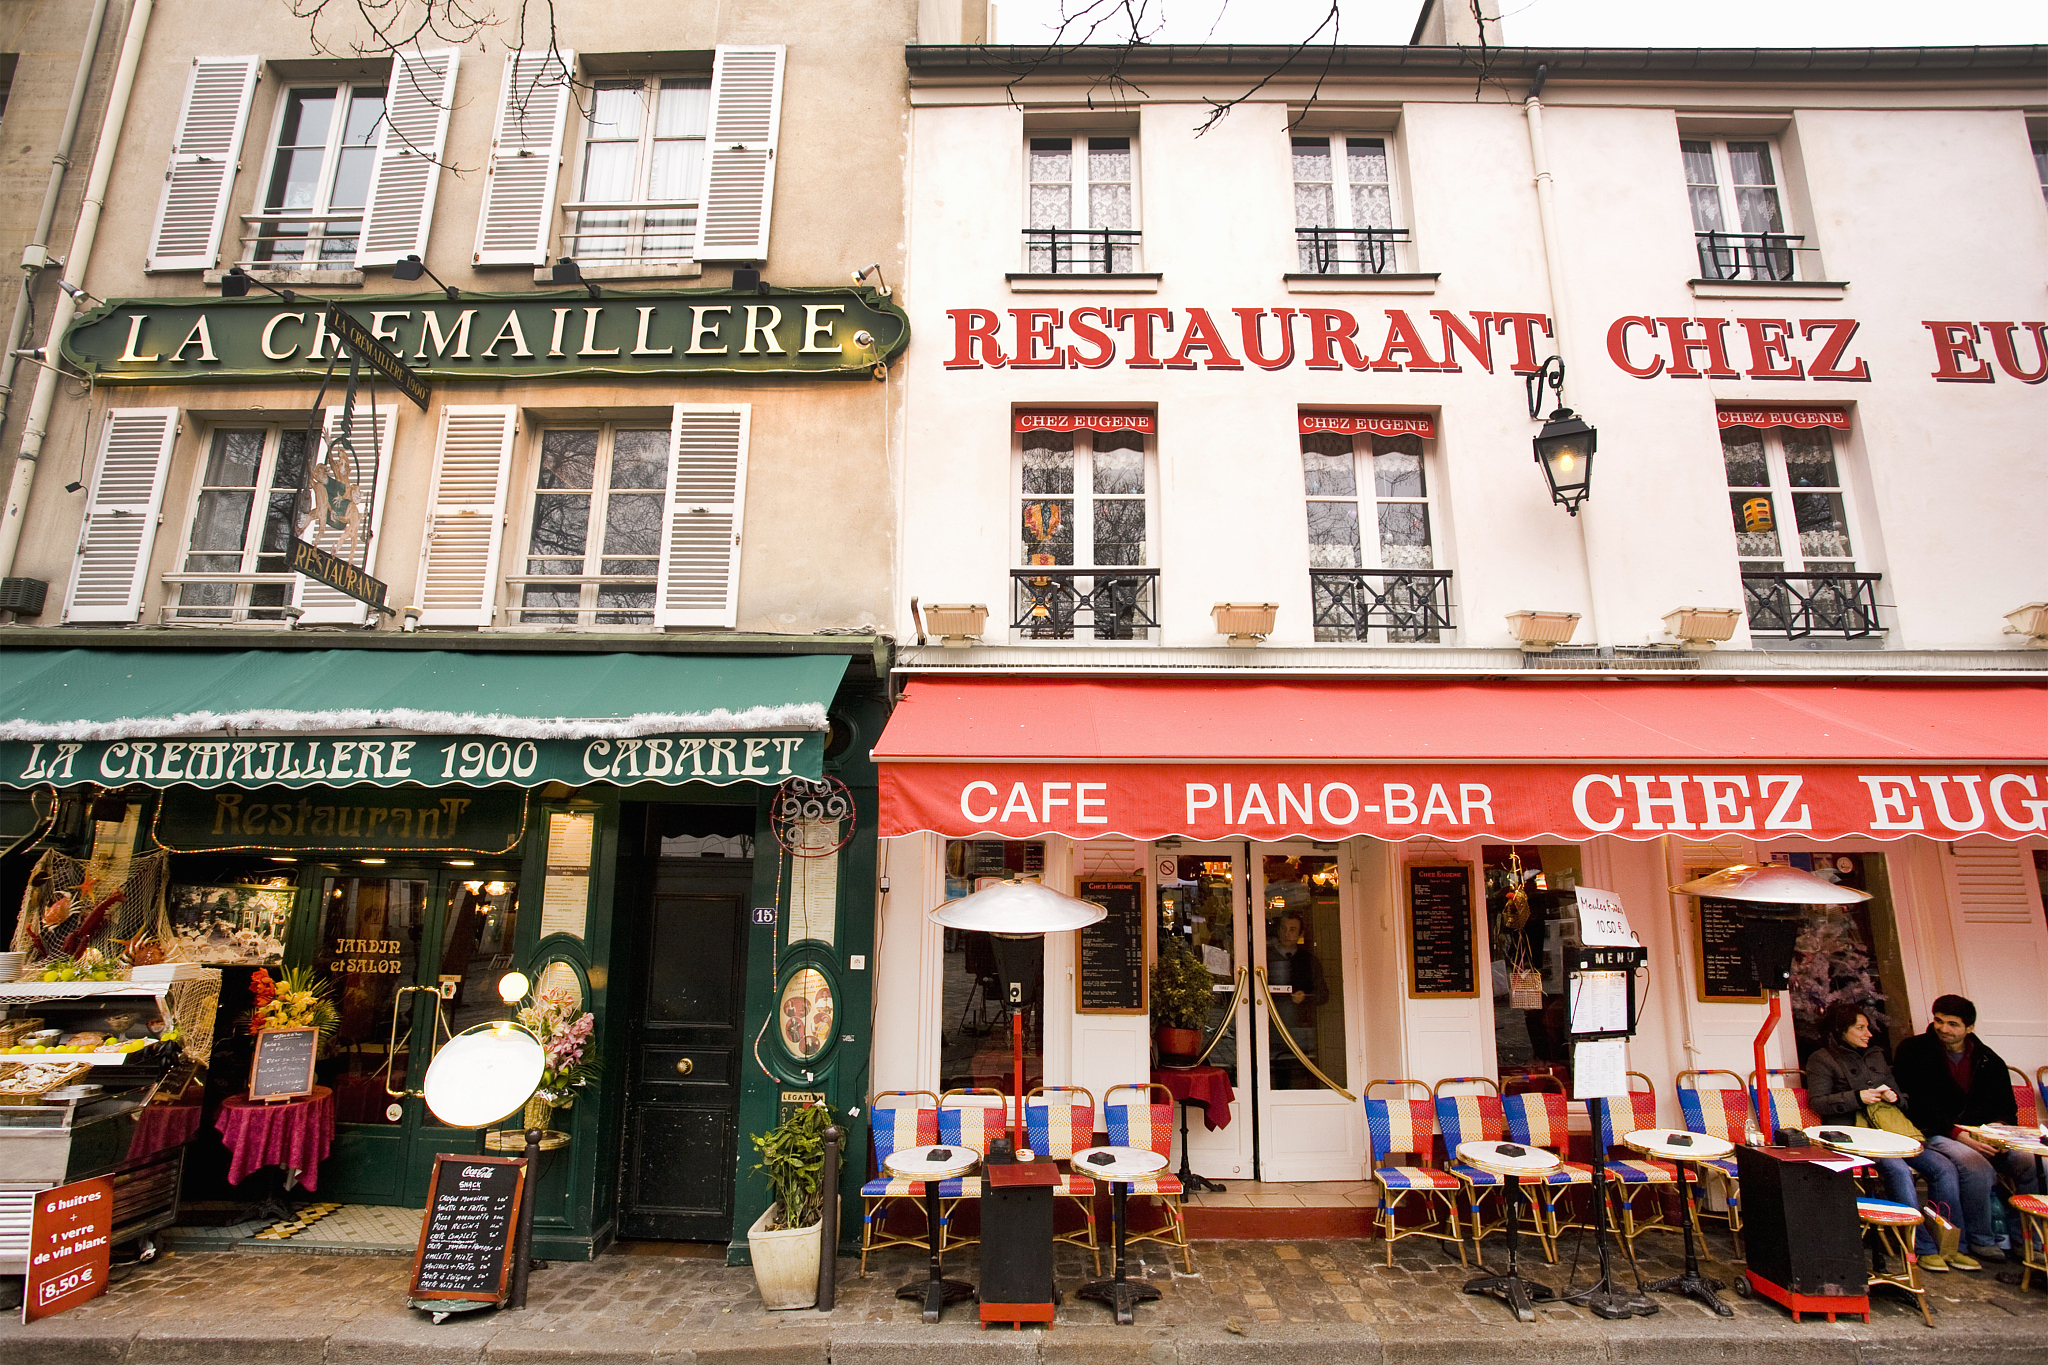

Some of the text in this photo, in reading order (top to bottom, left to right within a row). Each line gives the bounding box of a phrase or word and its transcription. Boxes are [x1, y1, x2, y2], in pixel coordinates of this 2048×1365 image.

[117, 313, 219, 363] LA
[943, 306, 1553, 375] RESTAURANT
[1606, 314, 2048, 386] CHEZ EU
[1021, 415, 1149, 428] CHEZ EUGENE
[1302, 416, 1429, 431] CHEZ EUGENE
[1717, 411, 1844, 424] CHEZ EUGENE
[294, 542, 382, 602] RESTAURANT
[20, 737, 804, 780] LA CREMAILLERE 1900 CABARET
[960, 780, 1496, 826] CAFE PIANO-BAR
[1572, 773, 2048, 832] CHEZ EUG
[756, 909, 773, 923] 15
[335, 938, 401, 954] JARDIN
[330, 958, 402, 974] et SALON
[1595, 951, 1635, 964] MENU
[46, 1202, 57, 1213] 6
[50, 1224, 95, 1244] 1 verre
[33, 1235, 107, 1266] de vin blanc
[44, 1273, 79, 1298] 8,50
